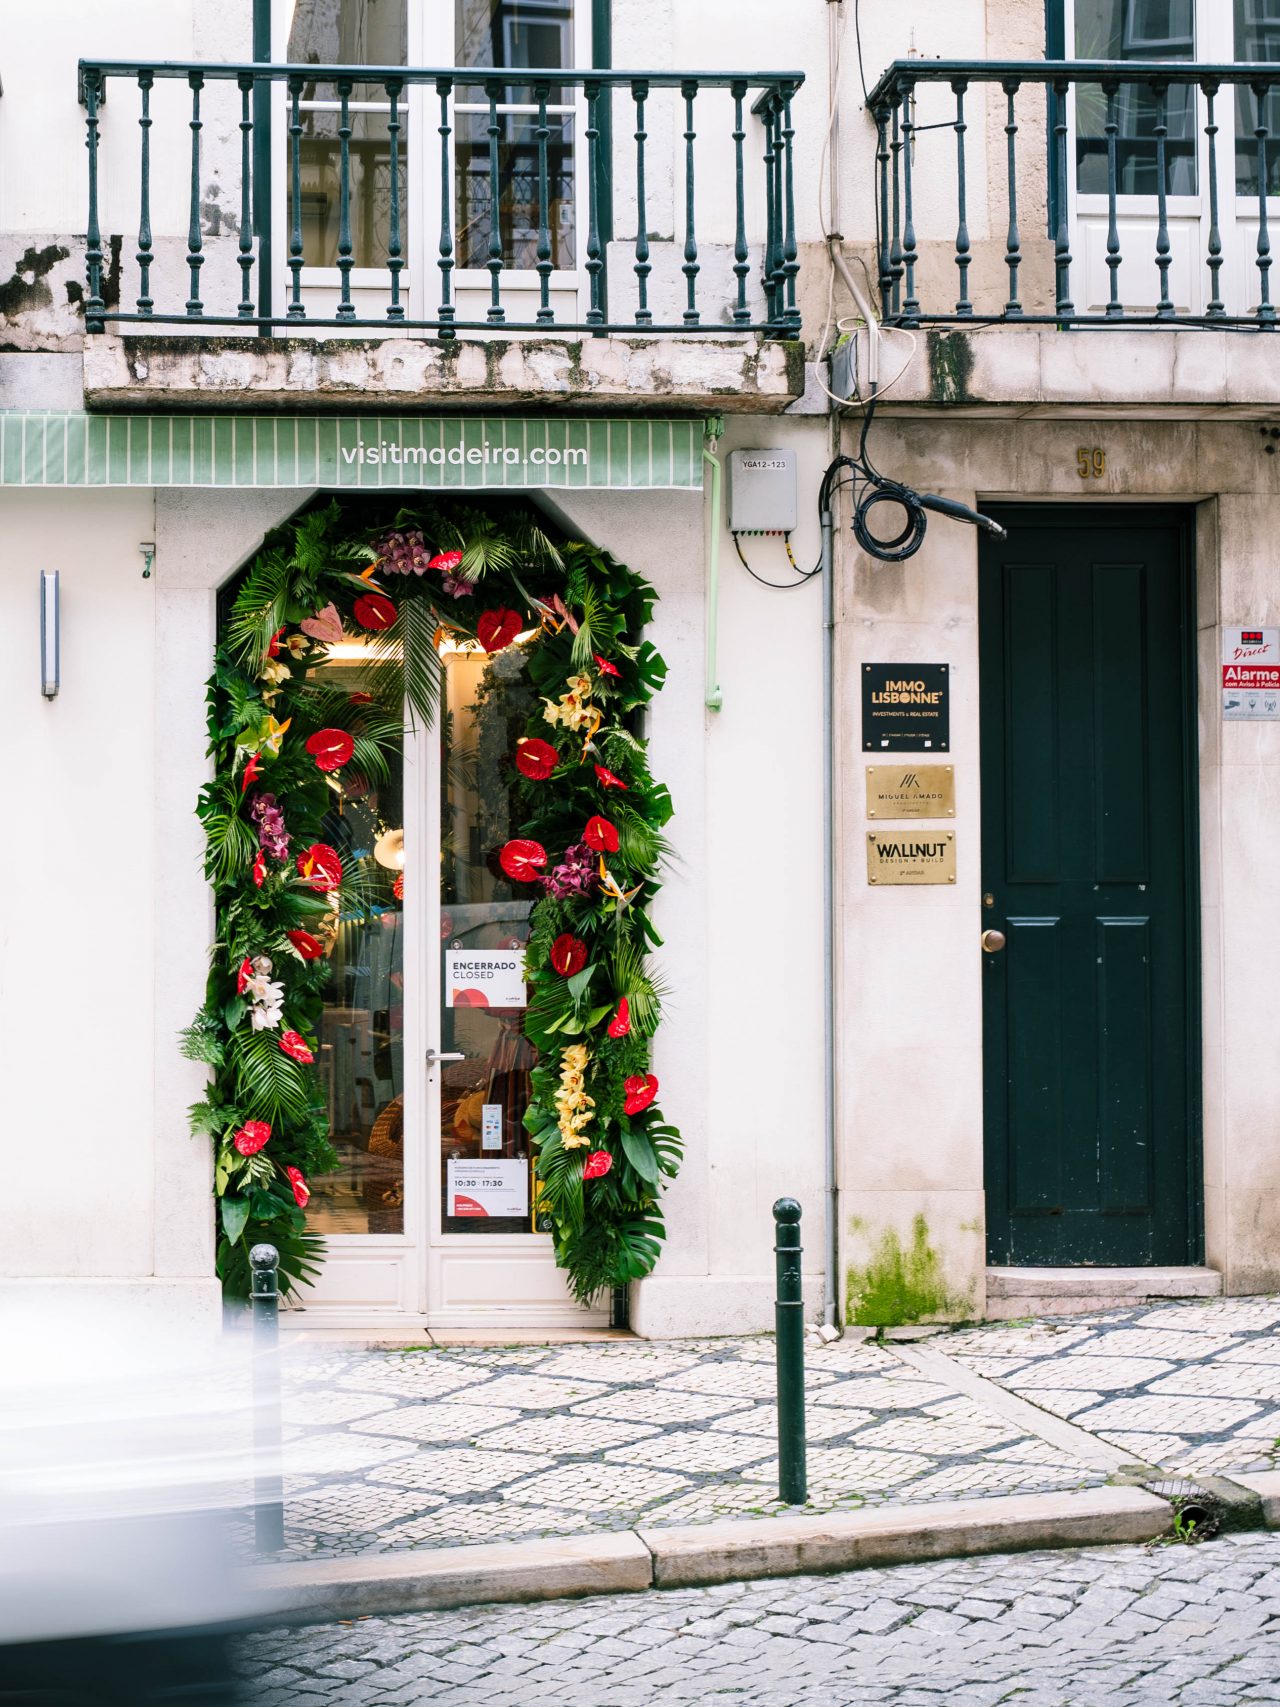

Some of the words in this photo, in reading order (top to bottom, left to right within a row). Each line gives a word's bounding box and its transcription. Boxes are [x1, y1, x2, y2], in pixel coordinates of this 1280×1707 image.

[341, 440, 588, 466] visitmadeira.com
[1077, 447, 1105, 479] 59
[1233, 643, 1272, 661] Direct
[1224, 666, 1280, 681] Alarme
[885, 680, 926, 692] IMMO
[876, 843, 947, 858] WALLNUT
[453, 962, 517, 970] ENCERRADO
[452, 971, 494, 979] CLOSED
